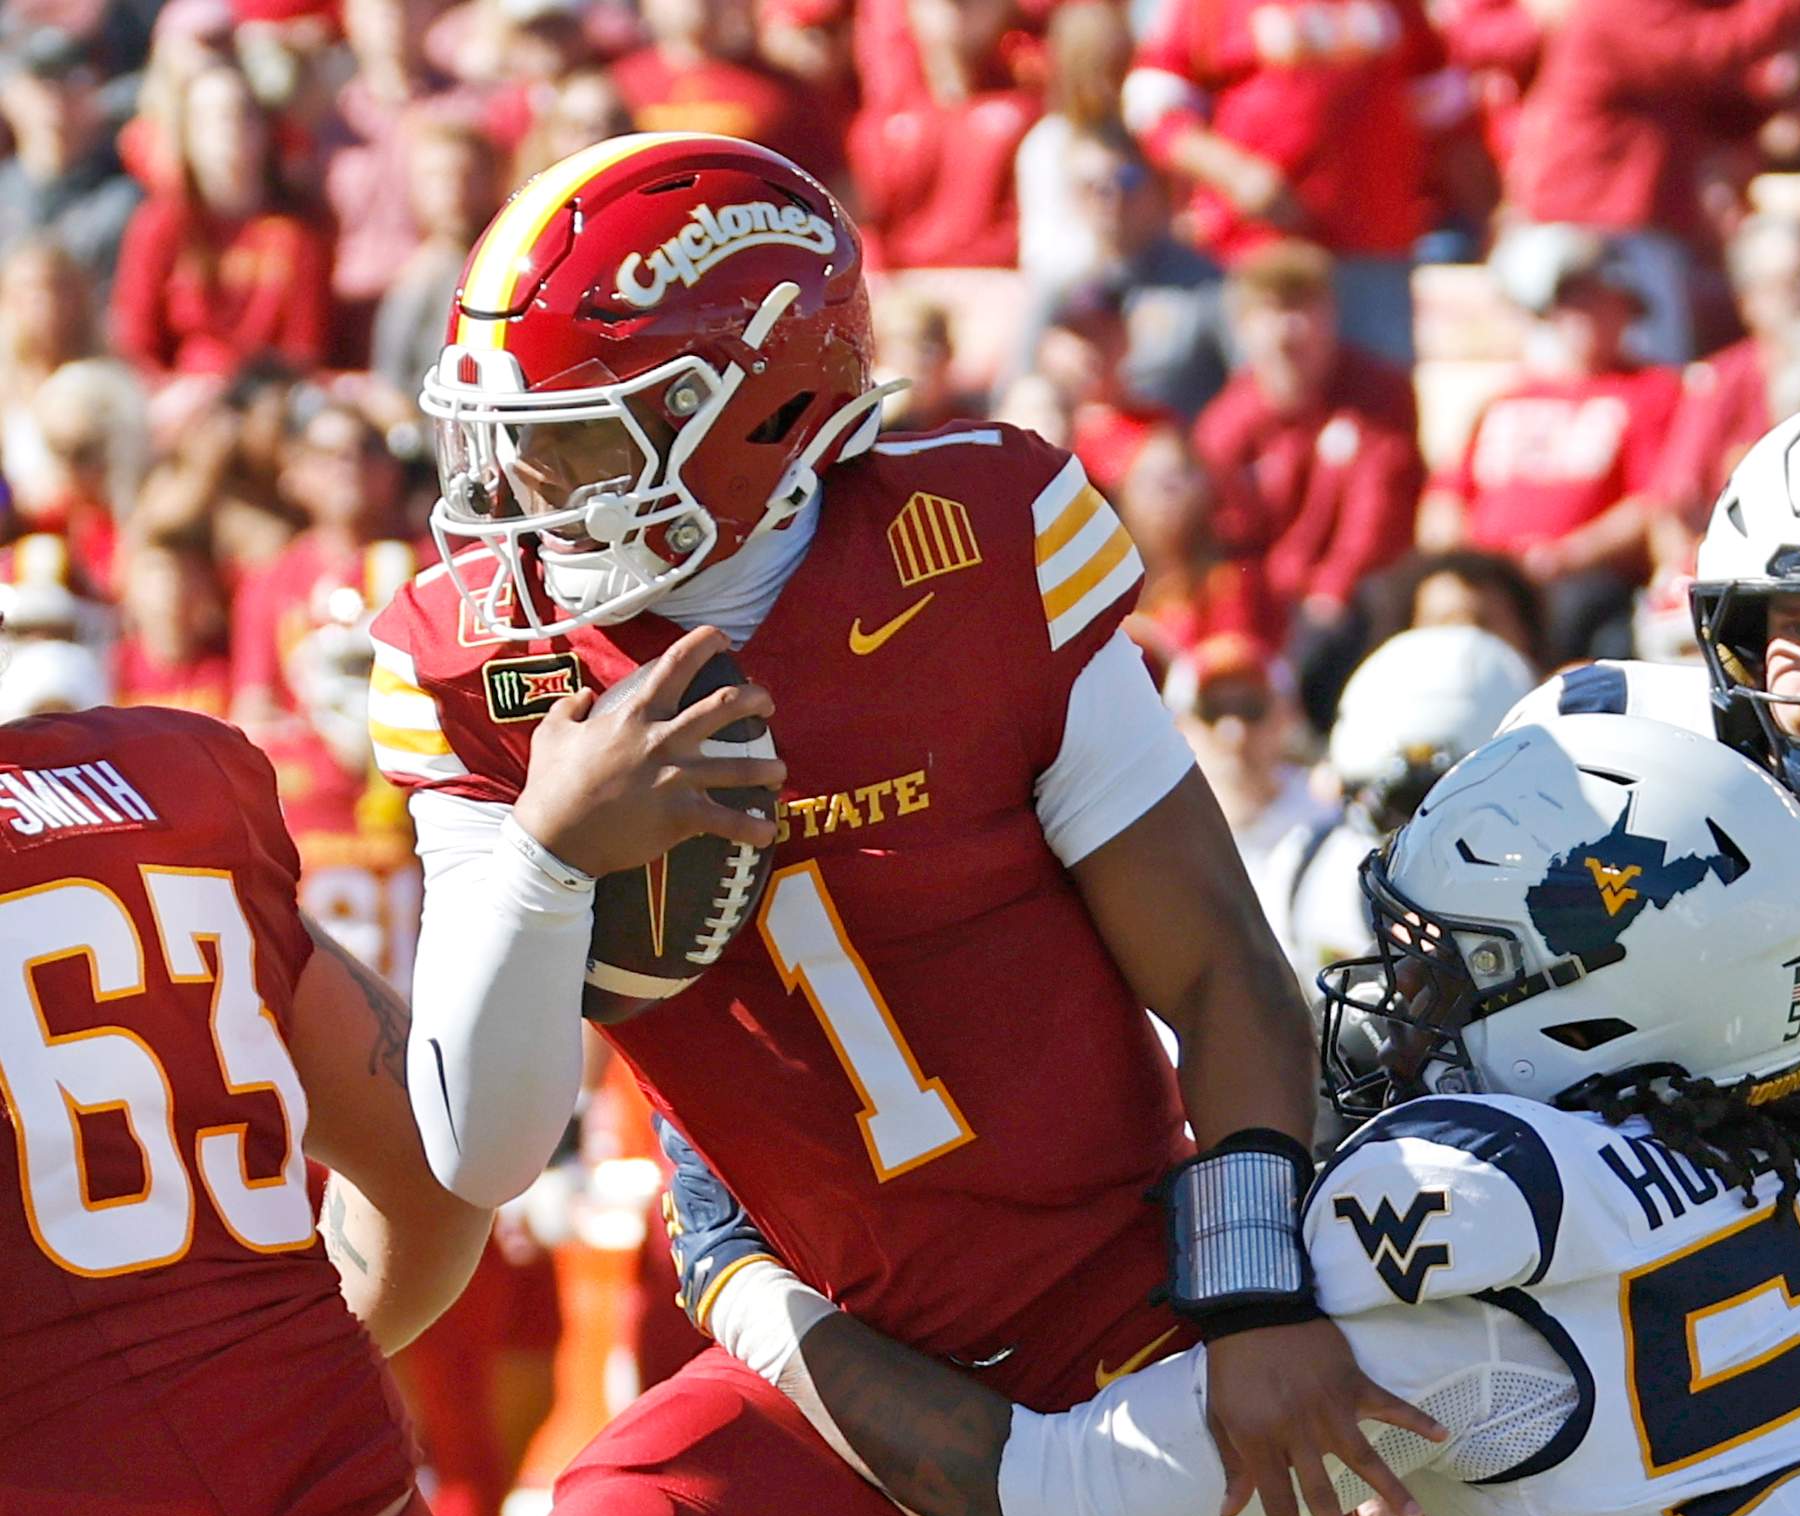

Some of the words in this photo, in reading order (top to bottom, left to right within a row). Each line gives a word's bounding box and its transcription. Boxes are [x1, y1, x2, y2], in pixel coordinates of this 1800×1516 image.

[614, 202, 837, 307] Cyclones
[0, 759, 158, 835] SMITH
[0, 863, 318, 1278] 63
[756, 857, 978, 1184] 1
